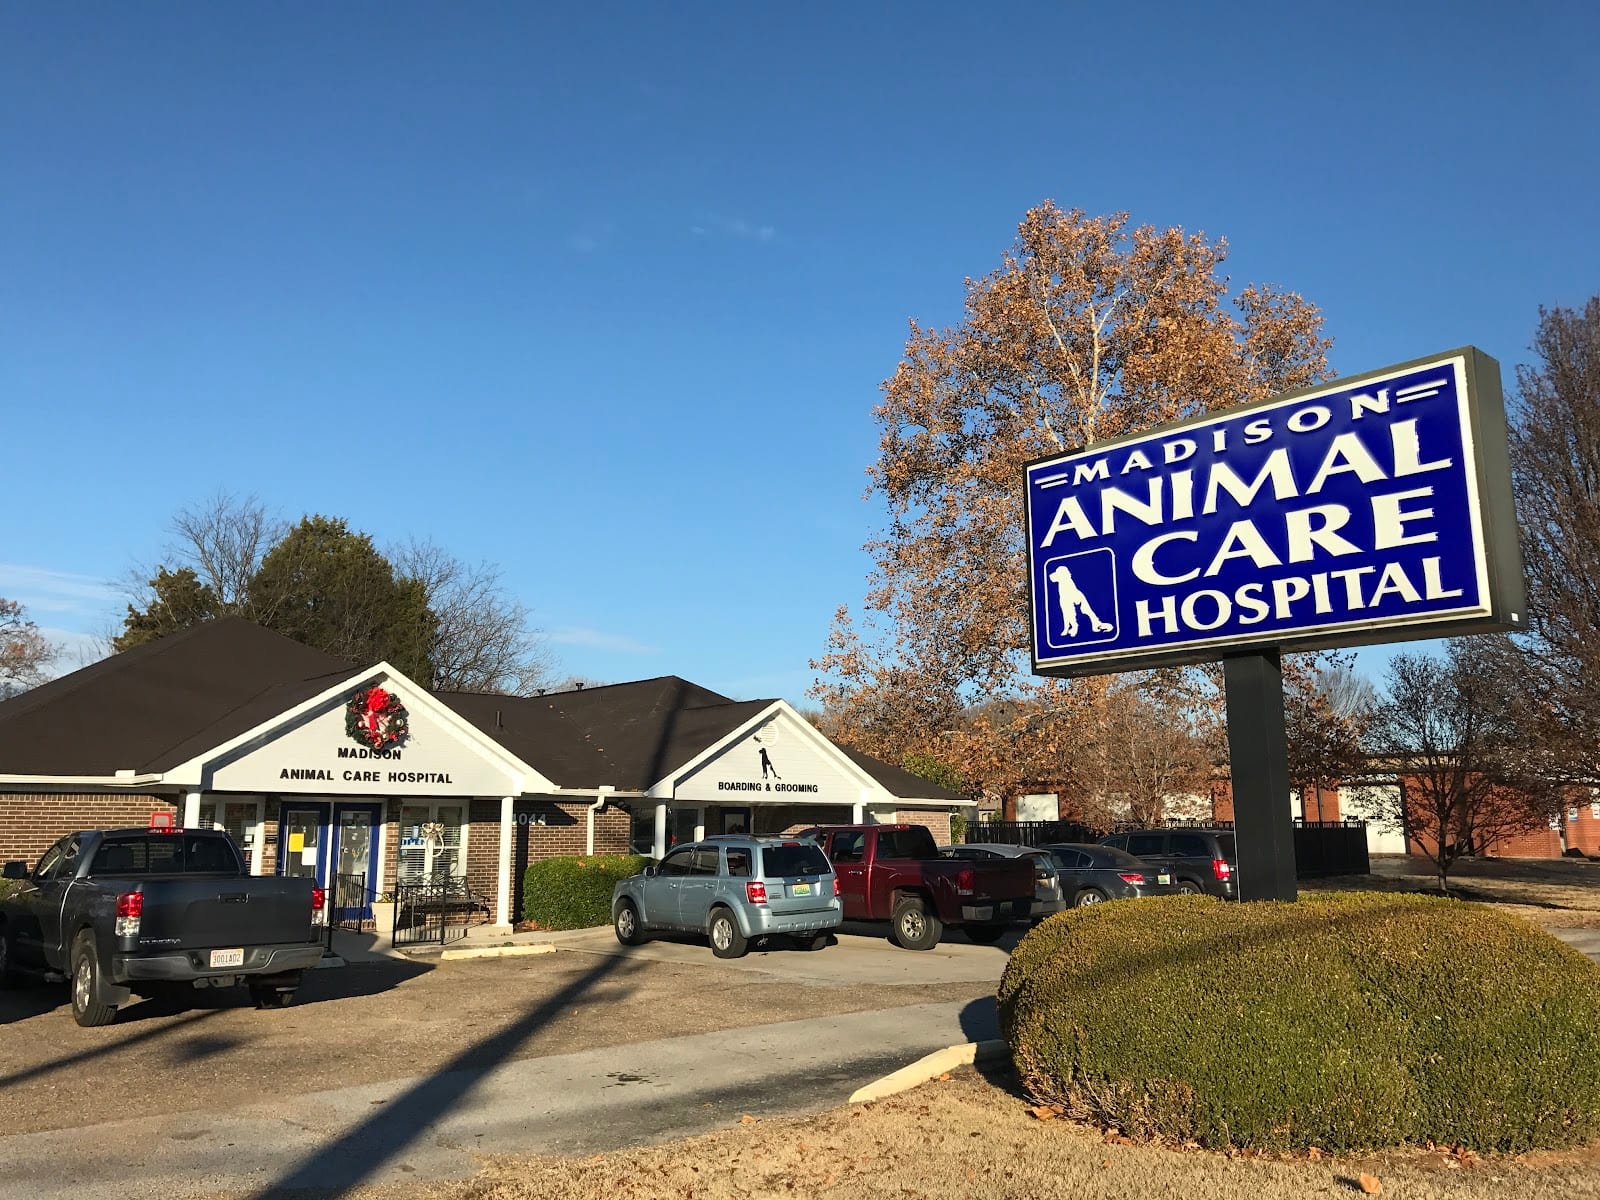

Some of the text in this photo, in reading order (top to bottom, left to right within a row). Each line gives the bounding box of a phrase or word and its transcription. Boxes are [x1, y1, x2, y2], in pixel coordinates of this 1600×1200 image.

[1072, 388, 1391, 486] MADISON
[1040, 417, 1453, 549] ANIMAL
[1131, 485, 1439, 586] CARE
[1135, 556, 1464, 638] HOSPITAL
[279, 768, 453, 784] ANIMAL CARE HOSPITAL
[337, 747, 402, 761] MADISON
[718, 781, 818, 793] BOARDING & GROOMING
